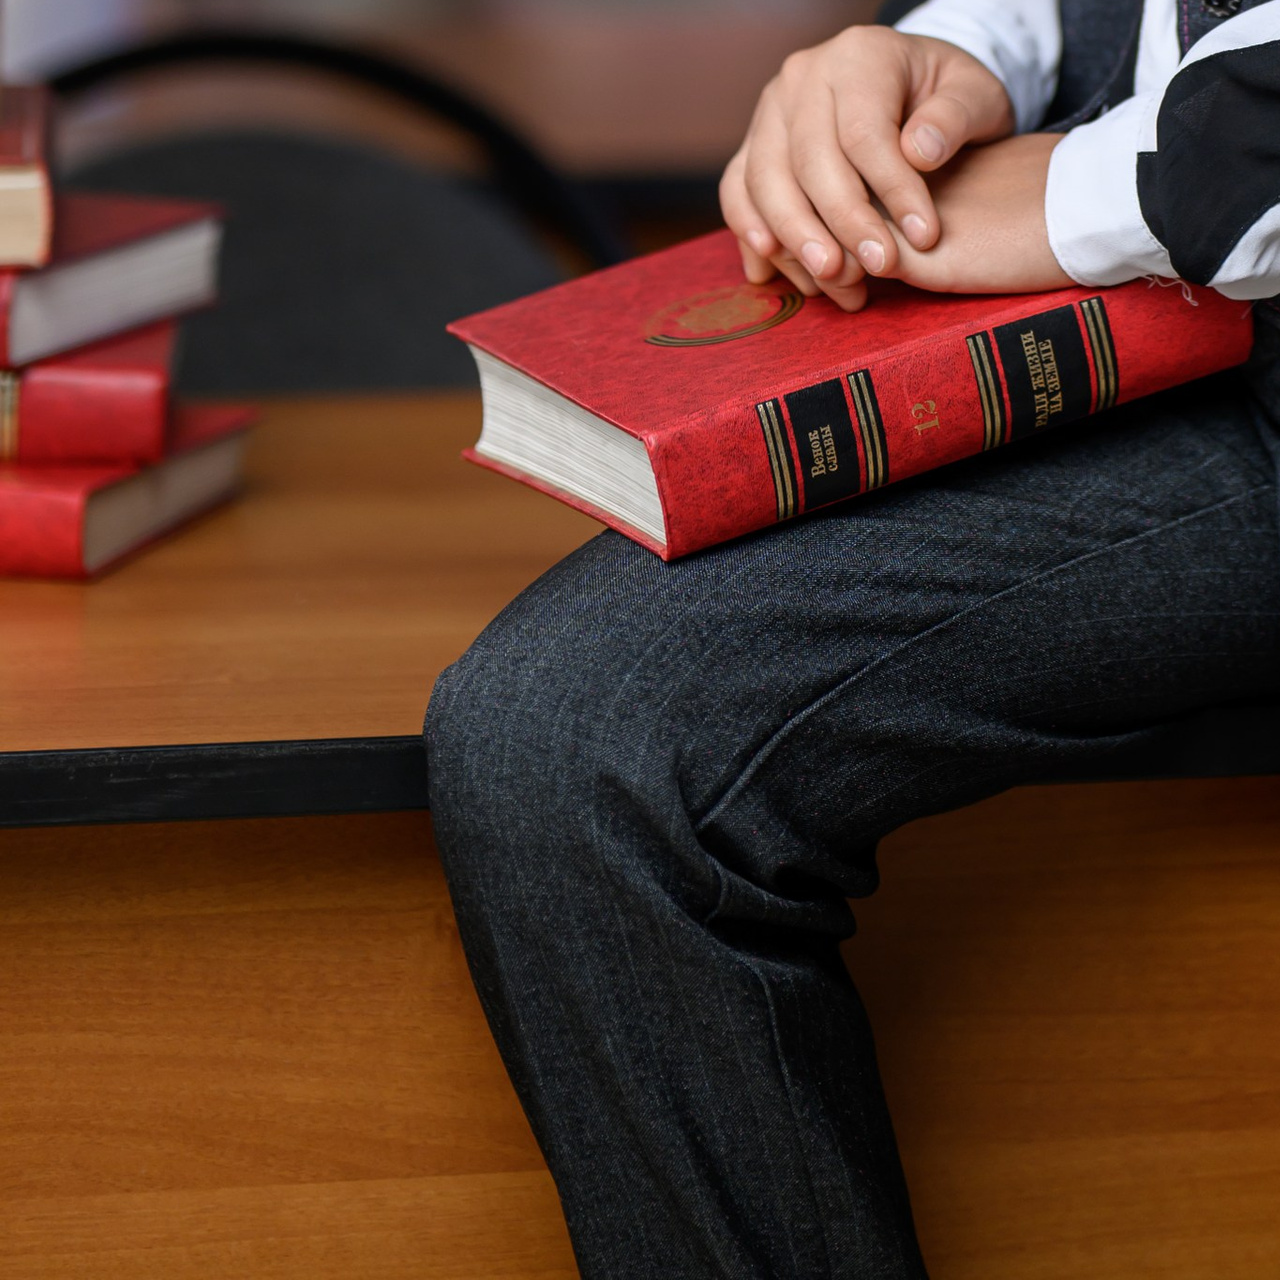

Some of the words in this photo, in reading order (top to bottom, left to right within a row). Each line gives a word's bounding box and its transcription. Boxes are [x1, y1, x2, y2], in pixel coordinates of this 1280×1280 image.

[1020, 330, 1046, 391] ЖИЗНИ
[1038, 339, 1061, 393] ЗЕМЛЕ
[912, 400, 941, 435] 12
[1035, 391, 1050, 429] РАДИ
[1050, 391, 1063, 415] НА
[808, 430, 827, 478] Венок
[819, 424, 838, 472] славы
